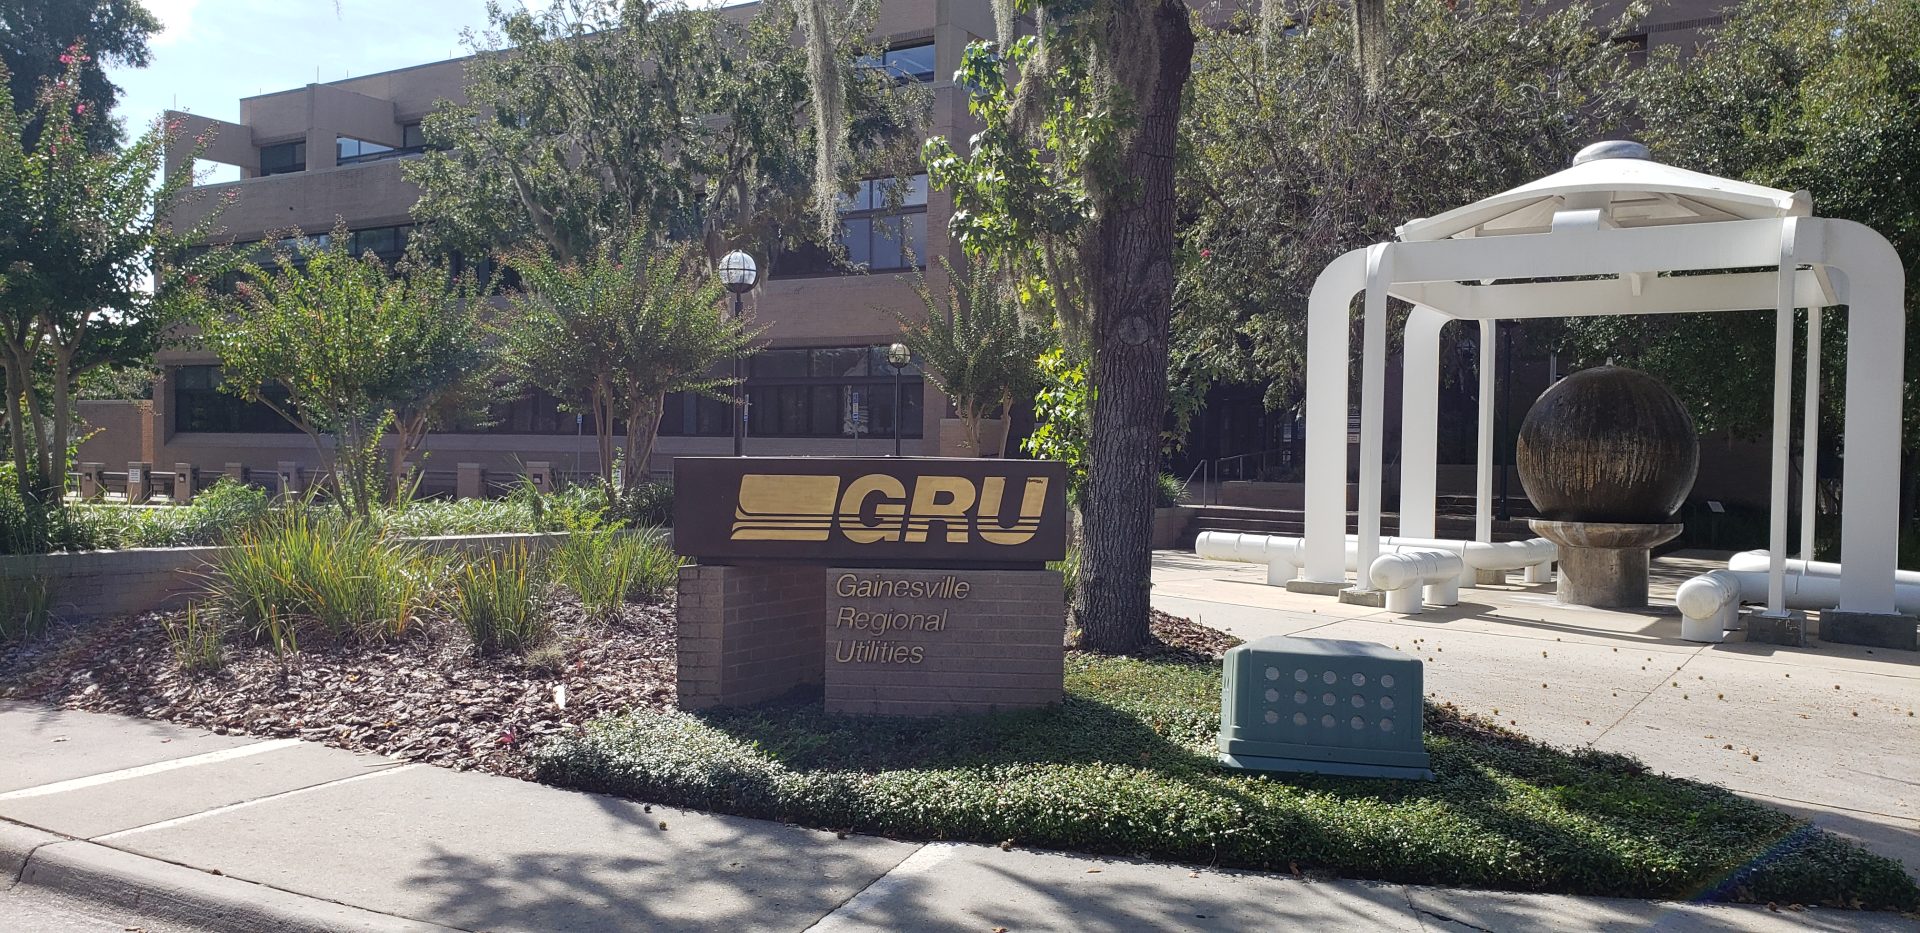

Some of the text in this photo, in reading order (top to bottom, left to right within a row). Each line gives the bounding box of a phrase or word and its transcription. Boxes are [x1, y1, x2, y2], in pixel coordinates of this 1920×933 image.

[838, 473, 1049, 545] GRU
[836, 573, 970, 599] Gainesville
[836, 606, 948, 636] Regional
[835, 640, 924, 664] Utilities
